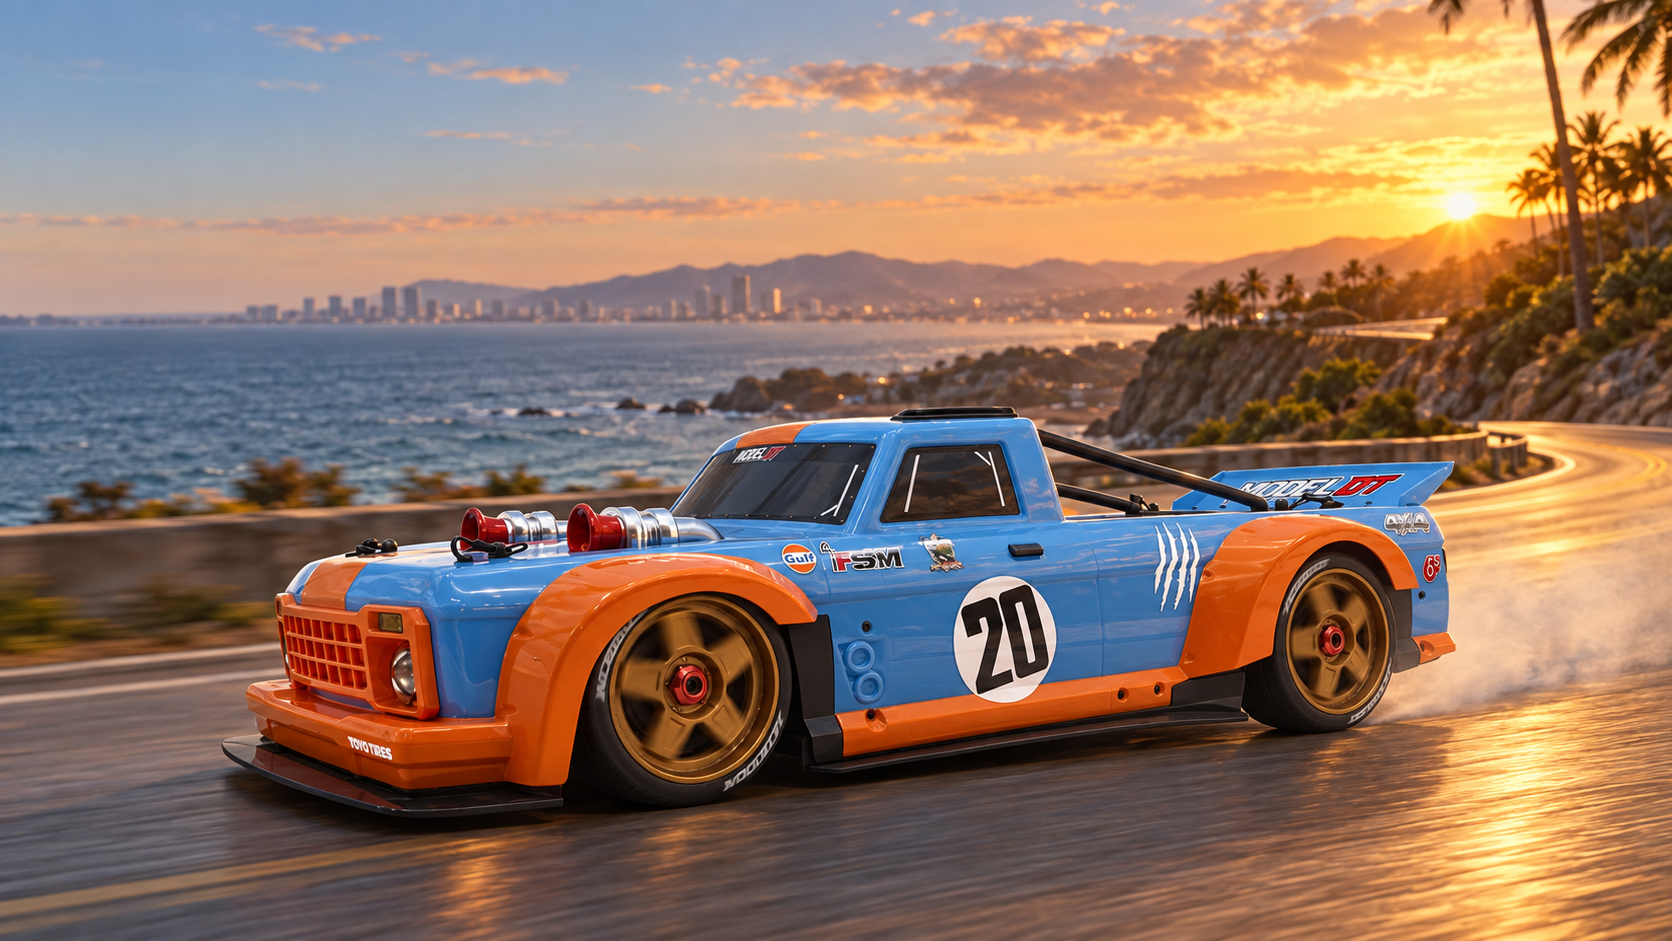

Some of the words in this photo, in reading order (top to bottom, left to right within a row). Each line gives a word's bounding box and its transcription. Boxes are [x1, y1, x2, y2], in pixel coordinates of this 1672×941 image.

[1239, 475, 1344, 499] MODEL
[1331, 473, 1405, 497] DT
[784, 553, 815, 564] Gulf
[961, 584, 1050, 696] 20
